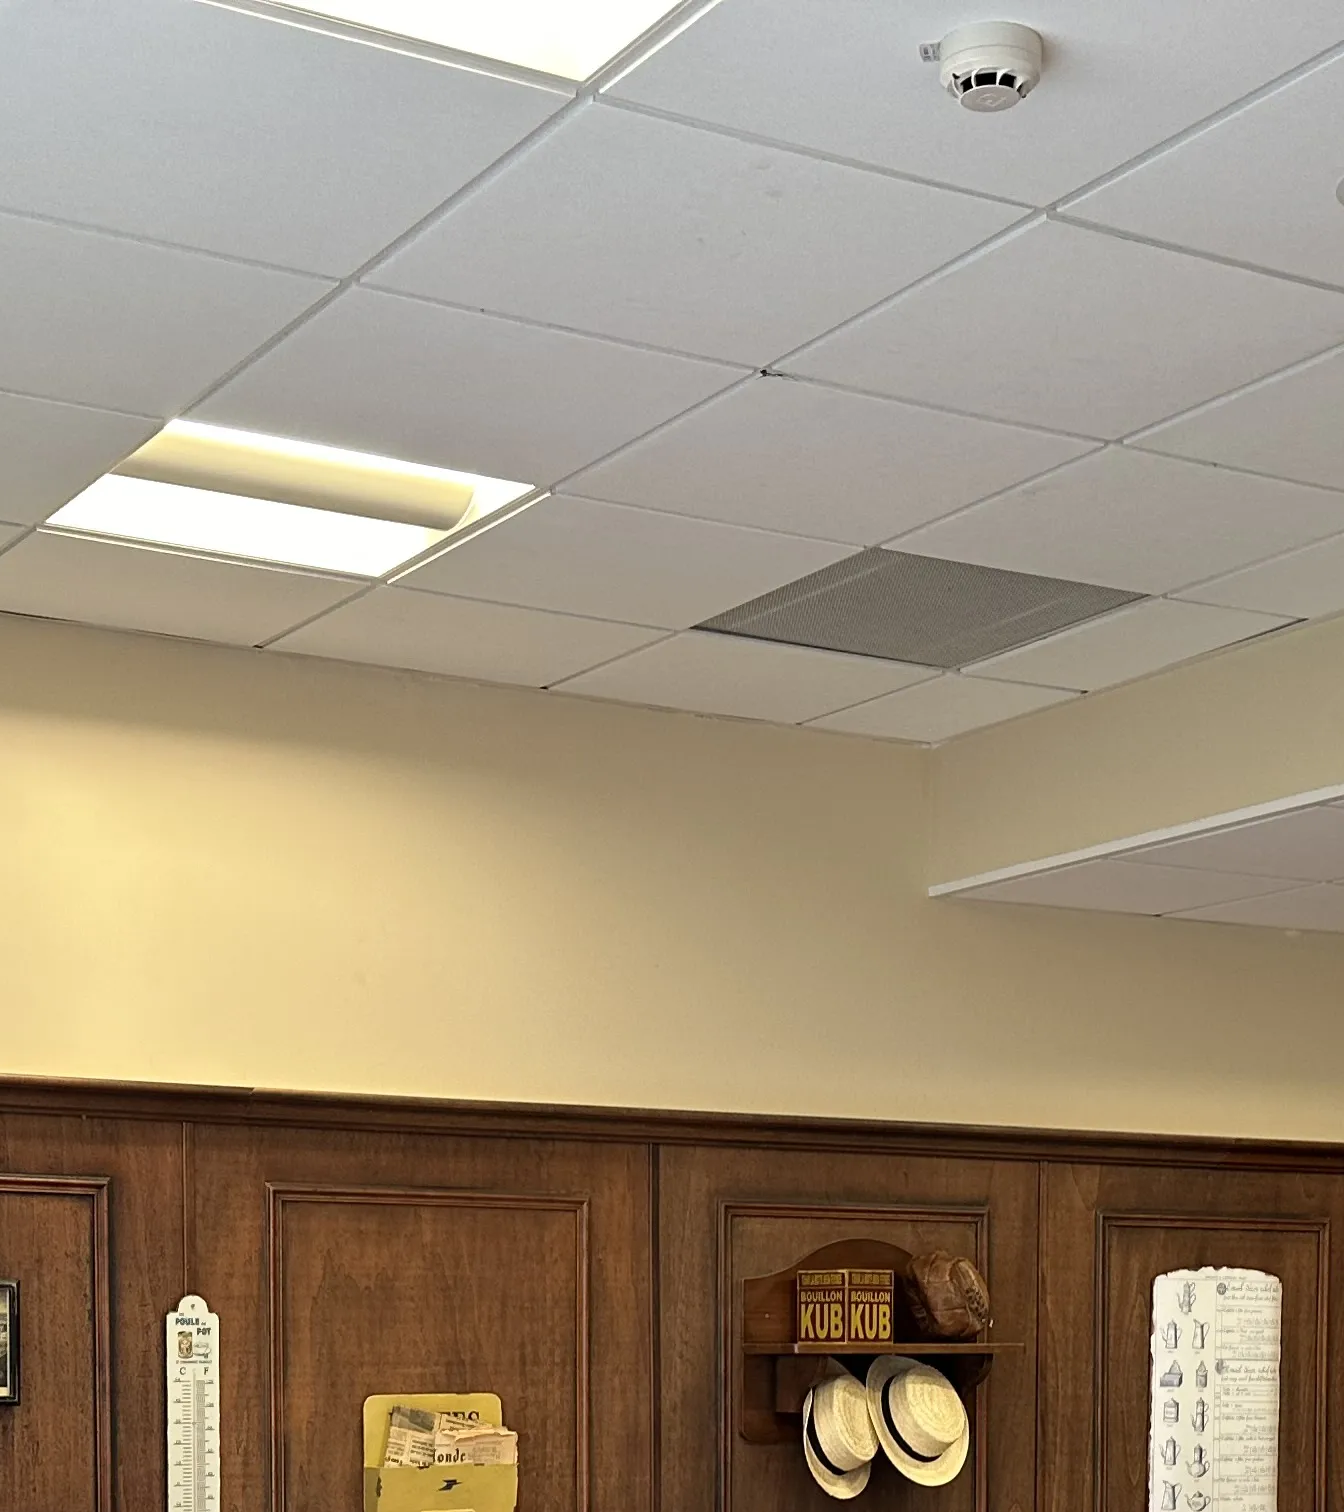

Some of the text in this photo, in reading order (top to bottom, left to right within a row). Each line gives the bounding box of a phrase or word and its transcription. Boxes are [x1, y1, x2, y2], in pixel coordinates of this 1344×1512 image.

[800, 1291, 843, 1303] BOUILLON
[850, 1291, 891, 1303] BOUILLON
[800, 1303, 844, 1339] KUB
[850, 1303, 892, 1340] KUB
